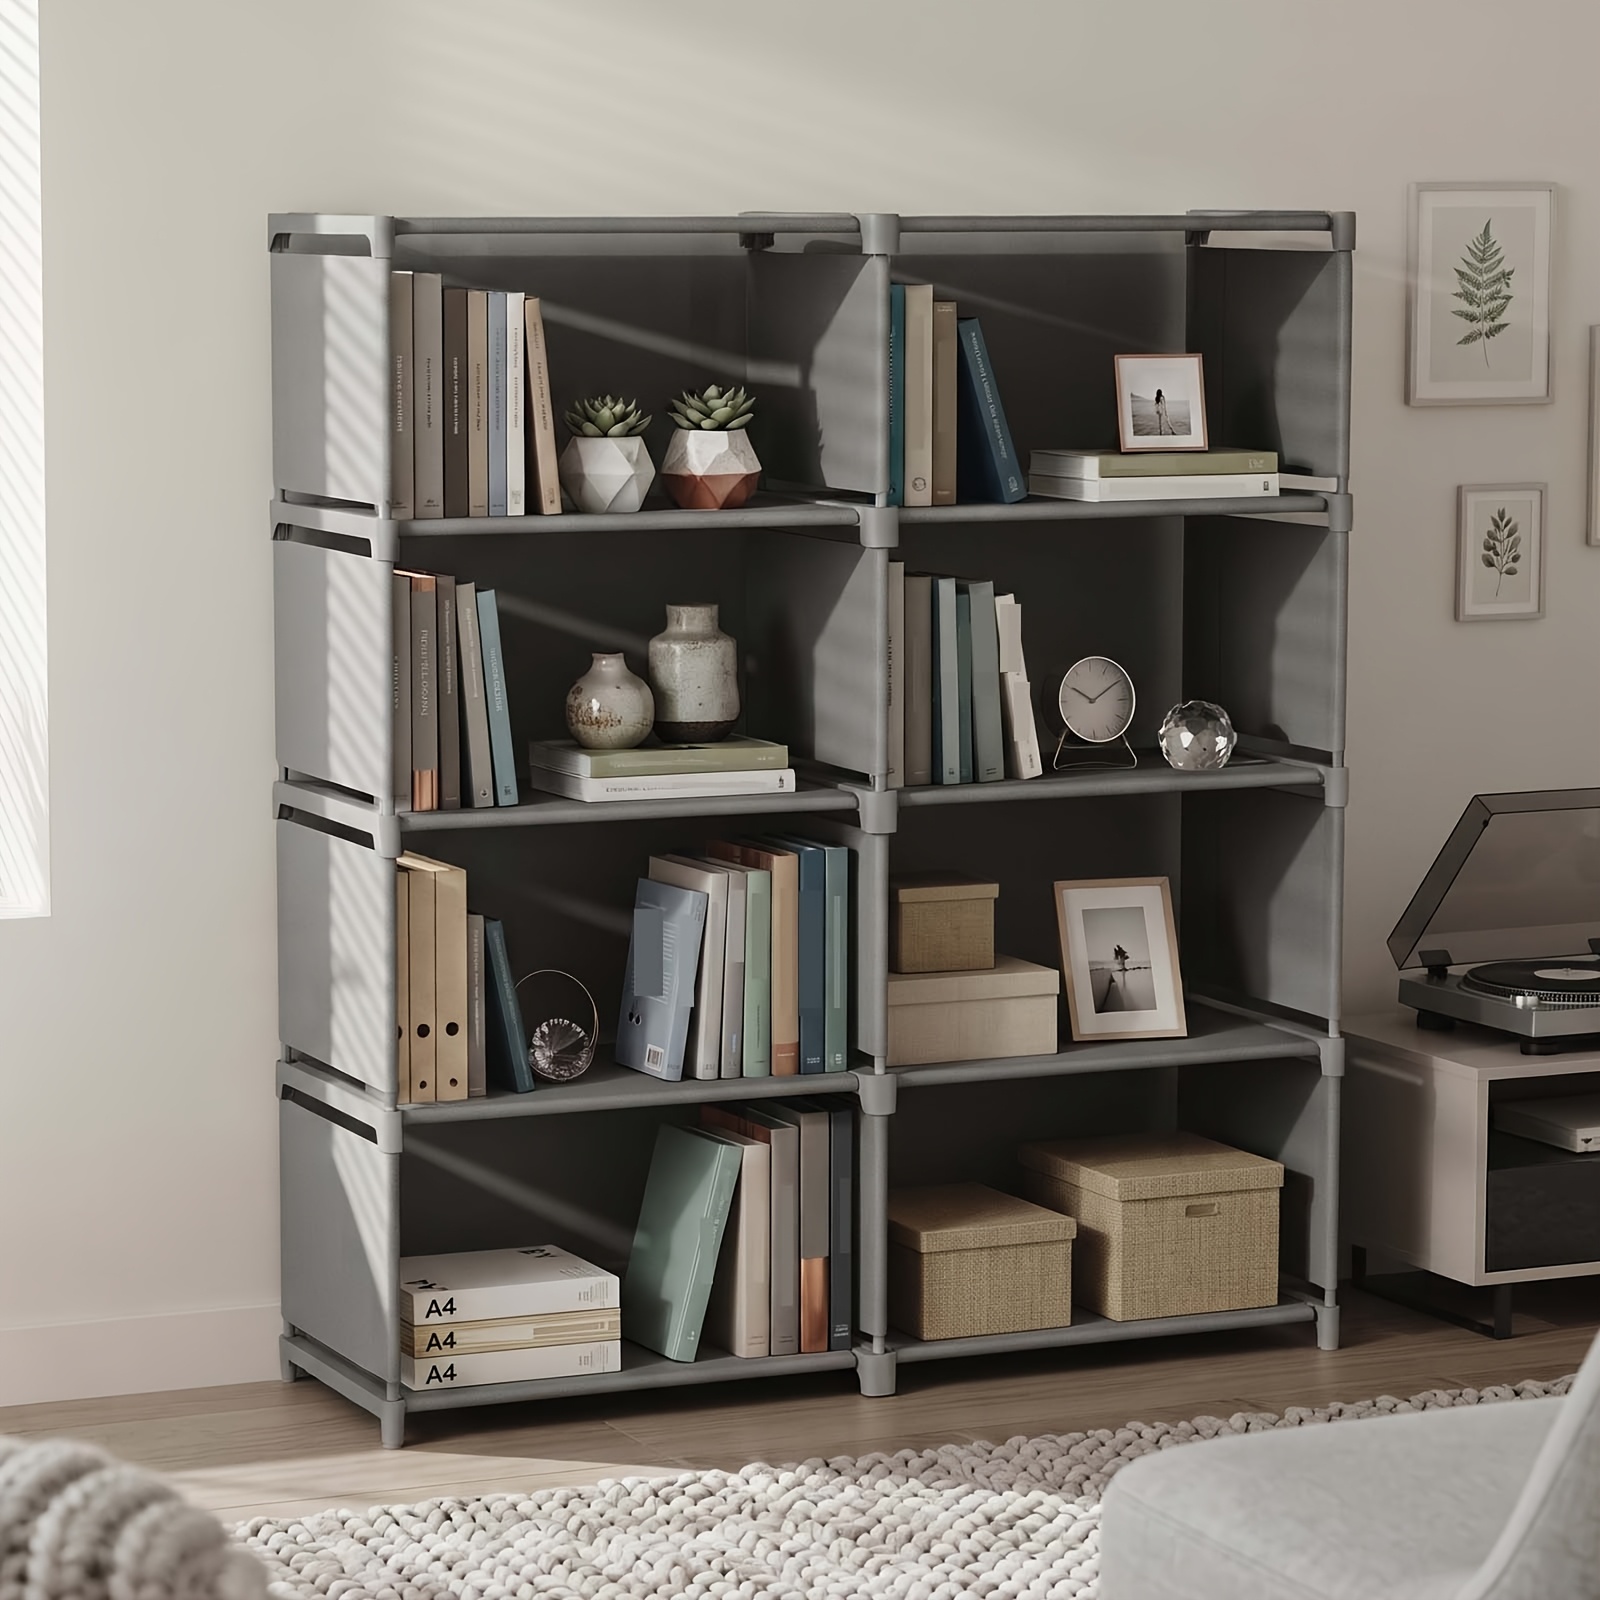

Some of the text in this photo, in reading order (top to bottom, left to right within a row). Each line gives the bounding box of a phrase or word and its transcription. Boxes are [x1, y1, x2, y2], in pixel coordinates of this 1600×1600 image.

[425, 1297, 457, 1318] A4
[425, 1331, 457, 1352] A4
[425, 1363, 457, 1385] A4
